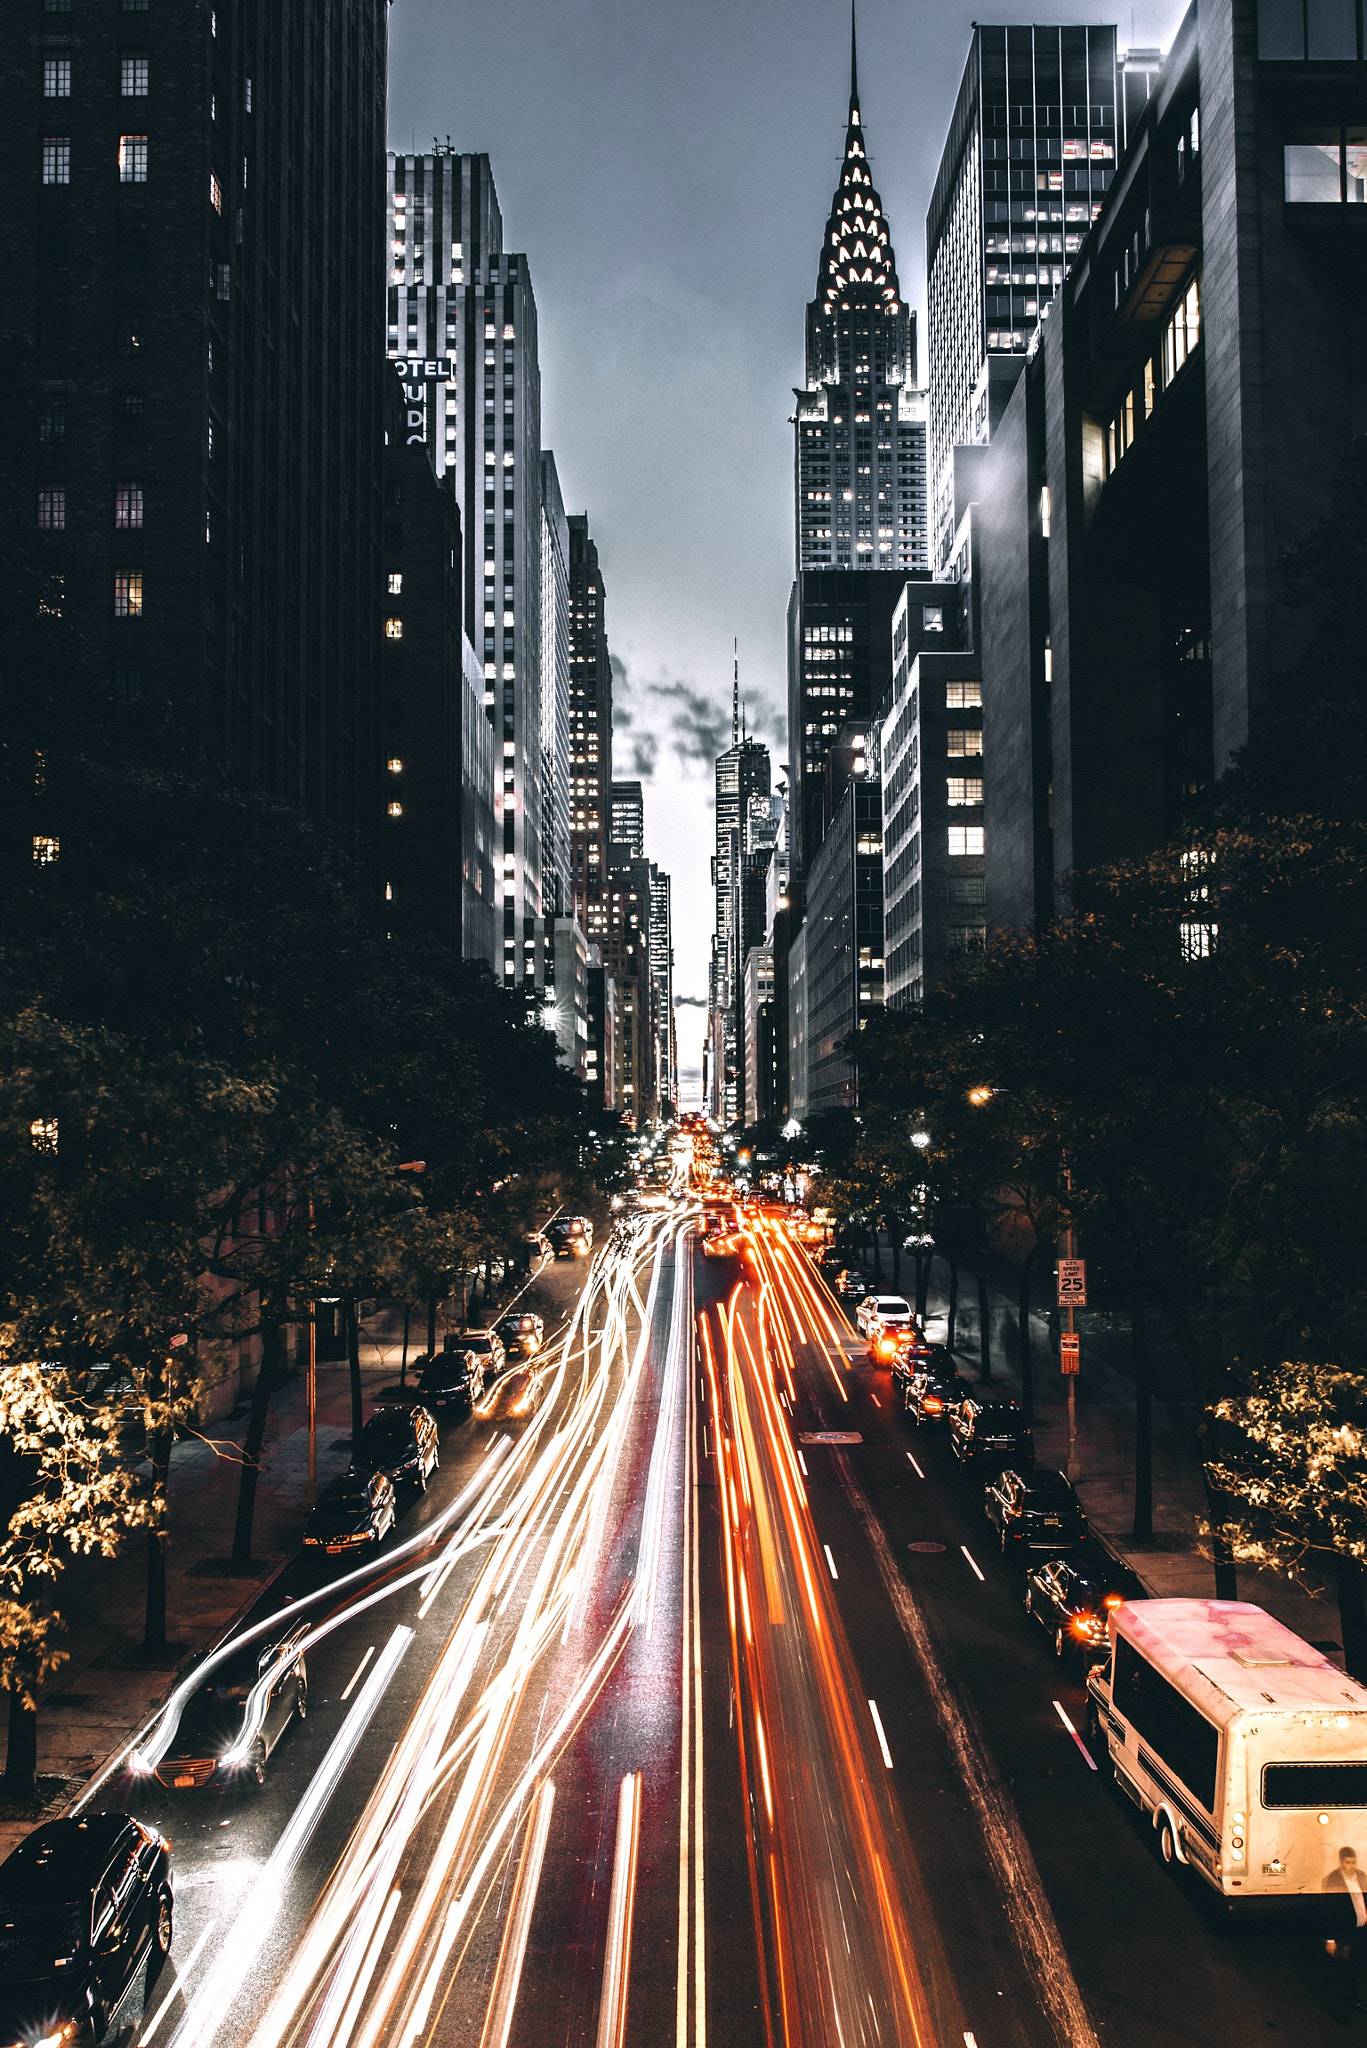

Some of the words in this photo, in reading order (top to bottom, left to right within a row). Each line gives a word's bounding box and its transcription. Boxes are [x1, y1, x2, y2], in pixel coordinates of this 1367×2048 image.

[394, 360, 450, 377] OTEL
[1061, 1277, 1083, 1291] 25
[1248, 1727, 1259, 1736] A5
